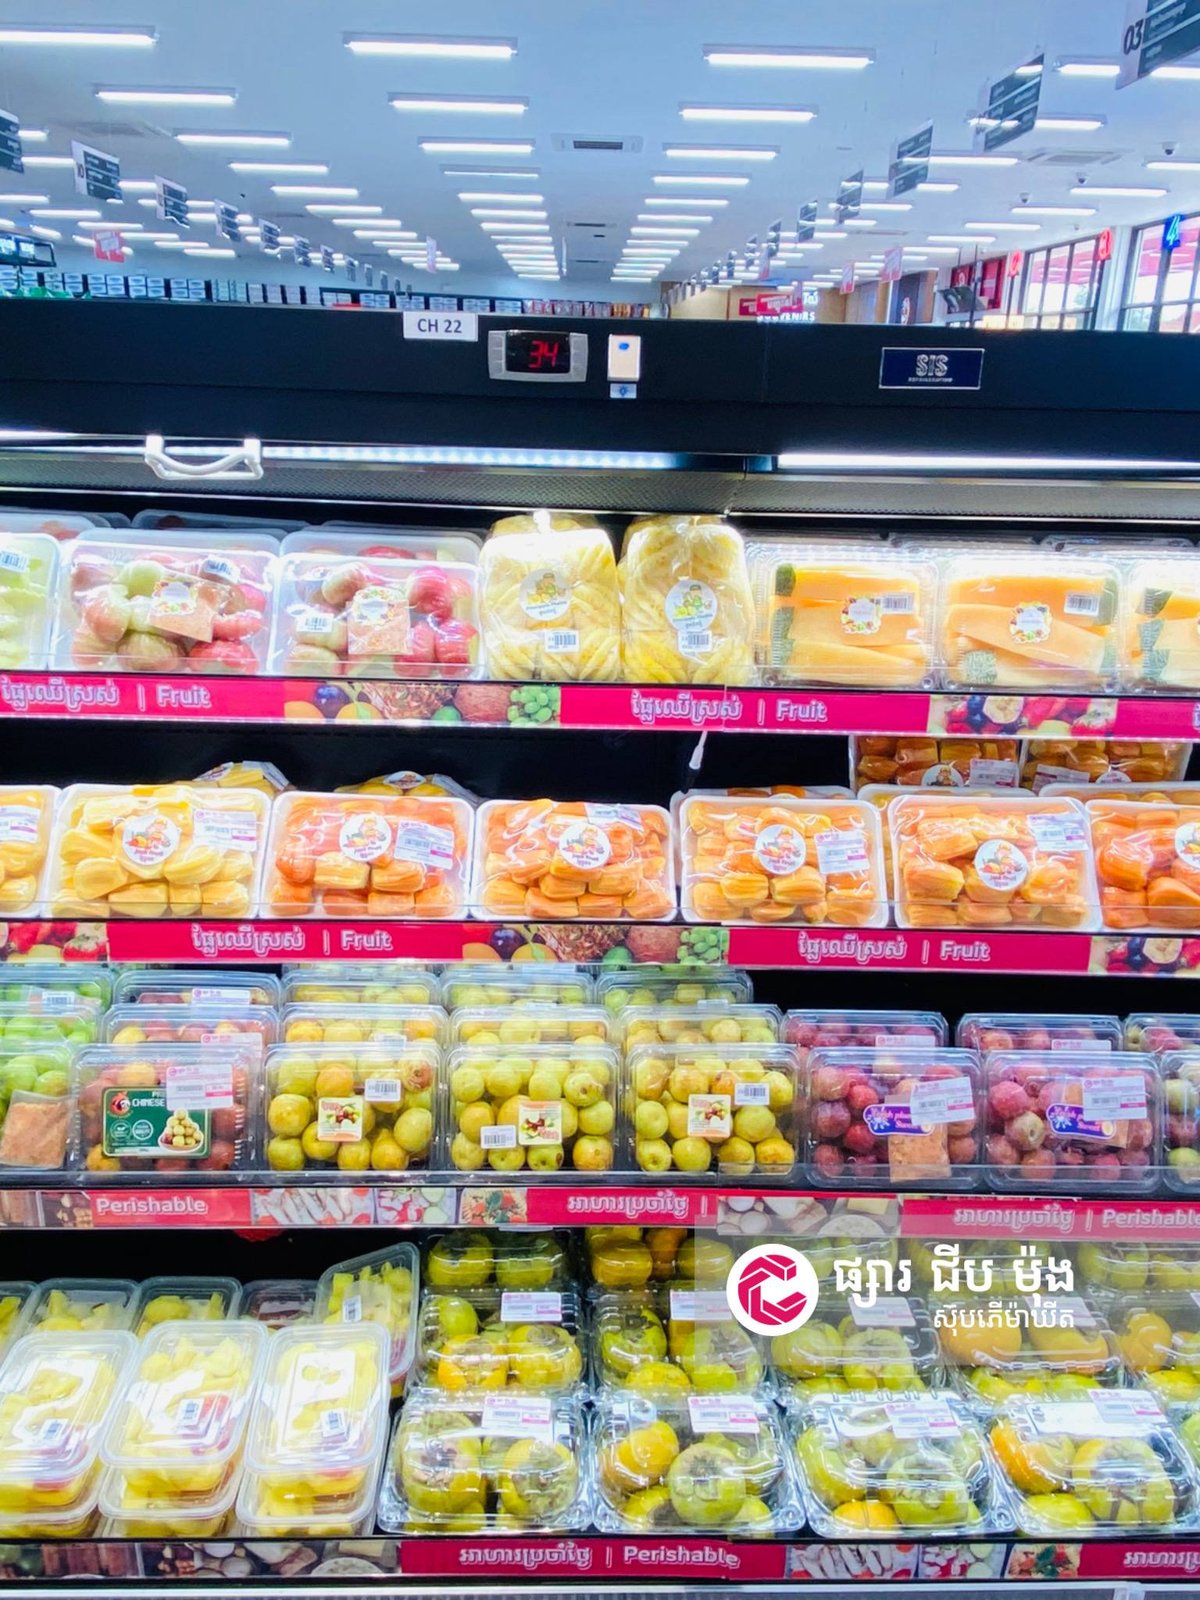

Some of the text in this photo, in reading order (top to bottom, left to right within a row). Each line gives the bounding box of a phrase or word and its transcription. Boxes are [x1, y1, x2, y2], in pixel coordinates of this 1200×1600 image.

[1123, 19, 1144, 55] 03
[417, 318, 462, 334] CH 22
[528, 340, 559, 369] 34
[915, 354, 949, 377] SIS
[156, 684, 211, 708] Fruit
[776, 699, 828, 721] Fruit
[341, 928, 393, 951] Fruit
[939, 939, 990, 961] Fruit
[131, 1098, 165, 1107] CHINESE
[96, 1195, 208, 1215] Perishable
[623, 1545, 740, 1569] Perishable
